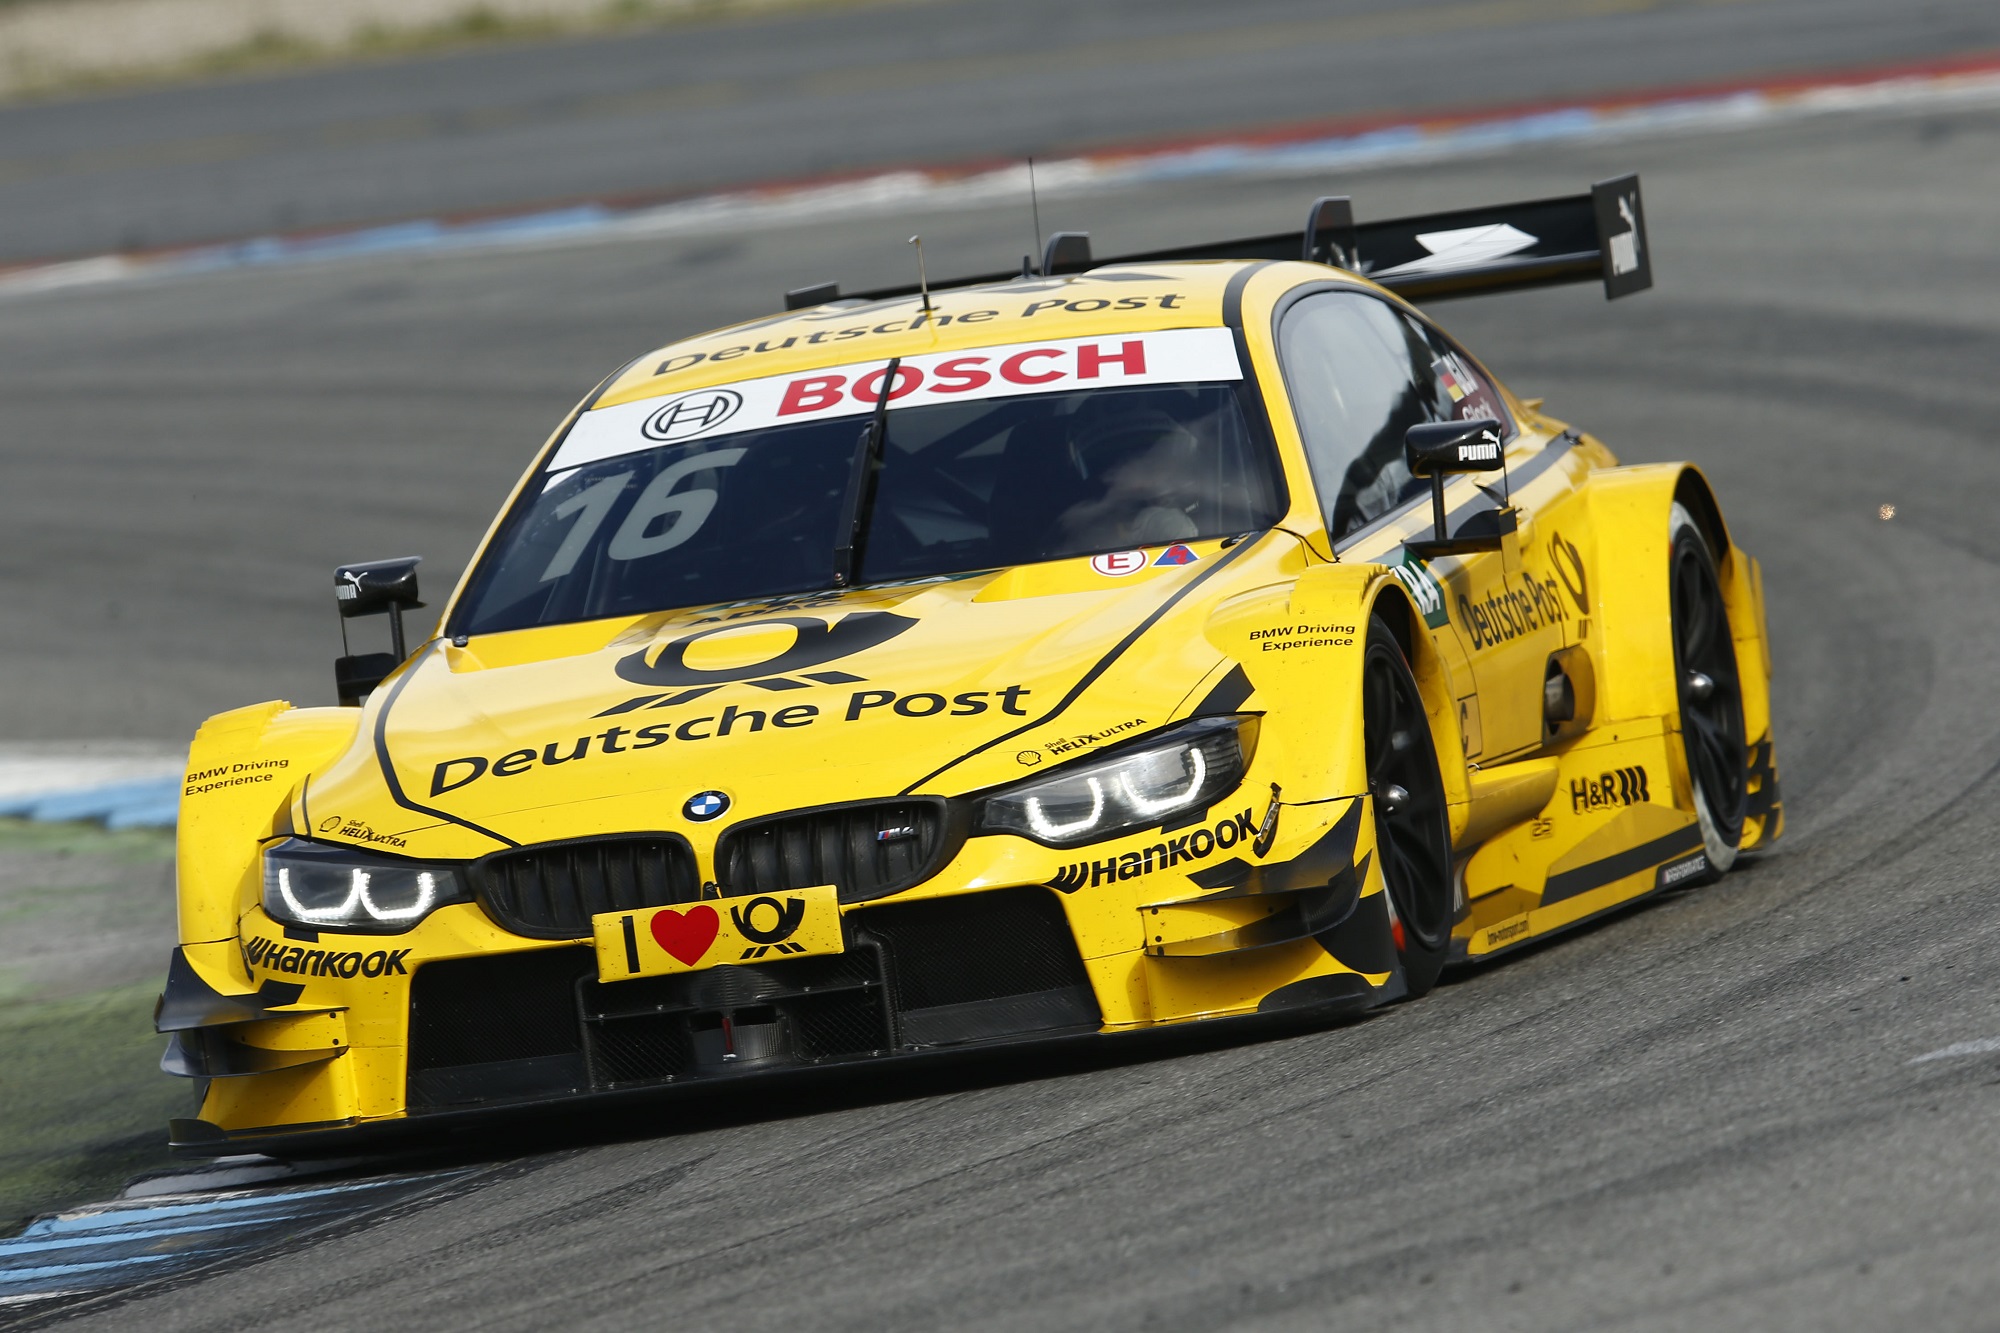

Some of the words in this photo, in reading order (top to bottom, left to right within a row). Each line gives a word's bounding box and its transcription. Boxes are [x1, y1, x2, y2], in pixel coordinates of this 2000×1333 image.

[653, 308, 998, 376] Deutsche
[1021, 294, 1185, 317] Post
[777, 340, 1146, 416] BOSCH
[1458, 443, 1497, 461] PUMA
[539, 447, 749, 582] 16
[1108, 550, 1130, 569] E
[1458, 576, 1537, 650] Deutsche
[1522, 571, 1568, 626] Post
[1250, 626, 1293, 640] BMW
[1297, 624, 1355, 634] Driving
[1263, 638, 1353, 651] Experience
[429, 705, 819, 798] Deutsche
[845, 685, 1031, 721] Post
[1045, 738, 1066, 749] Shell
[1050, 734, 1100, 755] HELIX
[1100, 718, 1147, 738] ULTRA
[185, 774, 273, 796] Experience
[187, 766, 228, 783] BMW
[233, 760, 289, 773] Driving
[1570, 773, 1618, 813] H&R
[338, 826, 375, 841] HELIX
[374, 834, 407, 848] ULTRA
[622, 915, 641, 974] I
